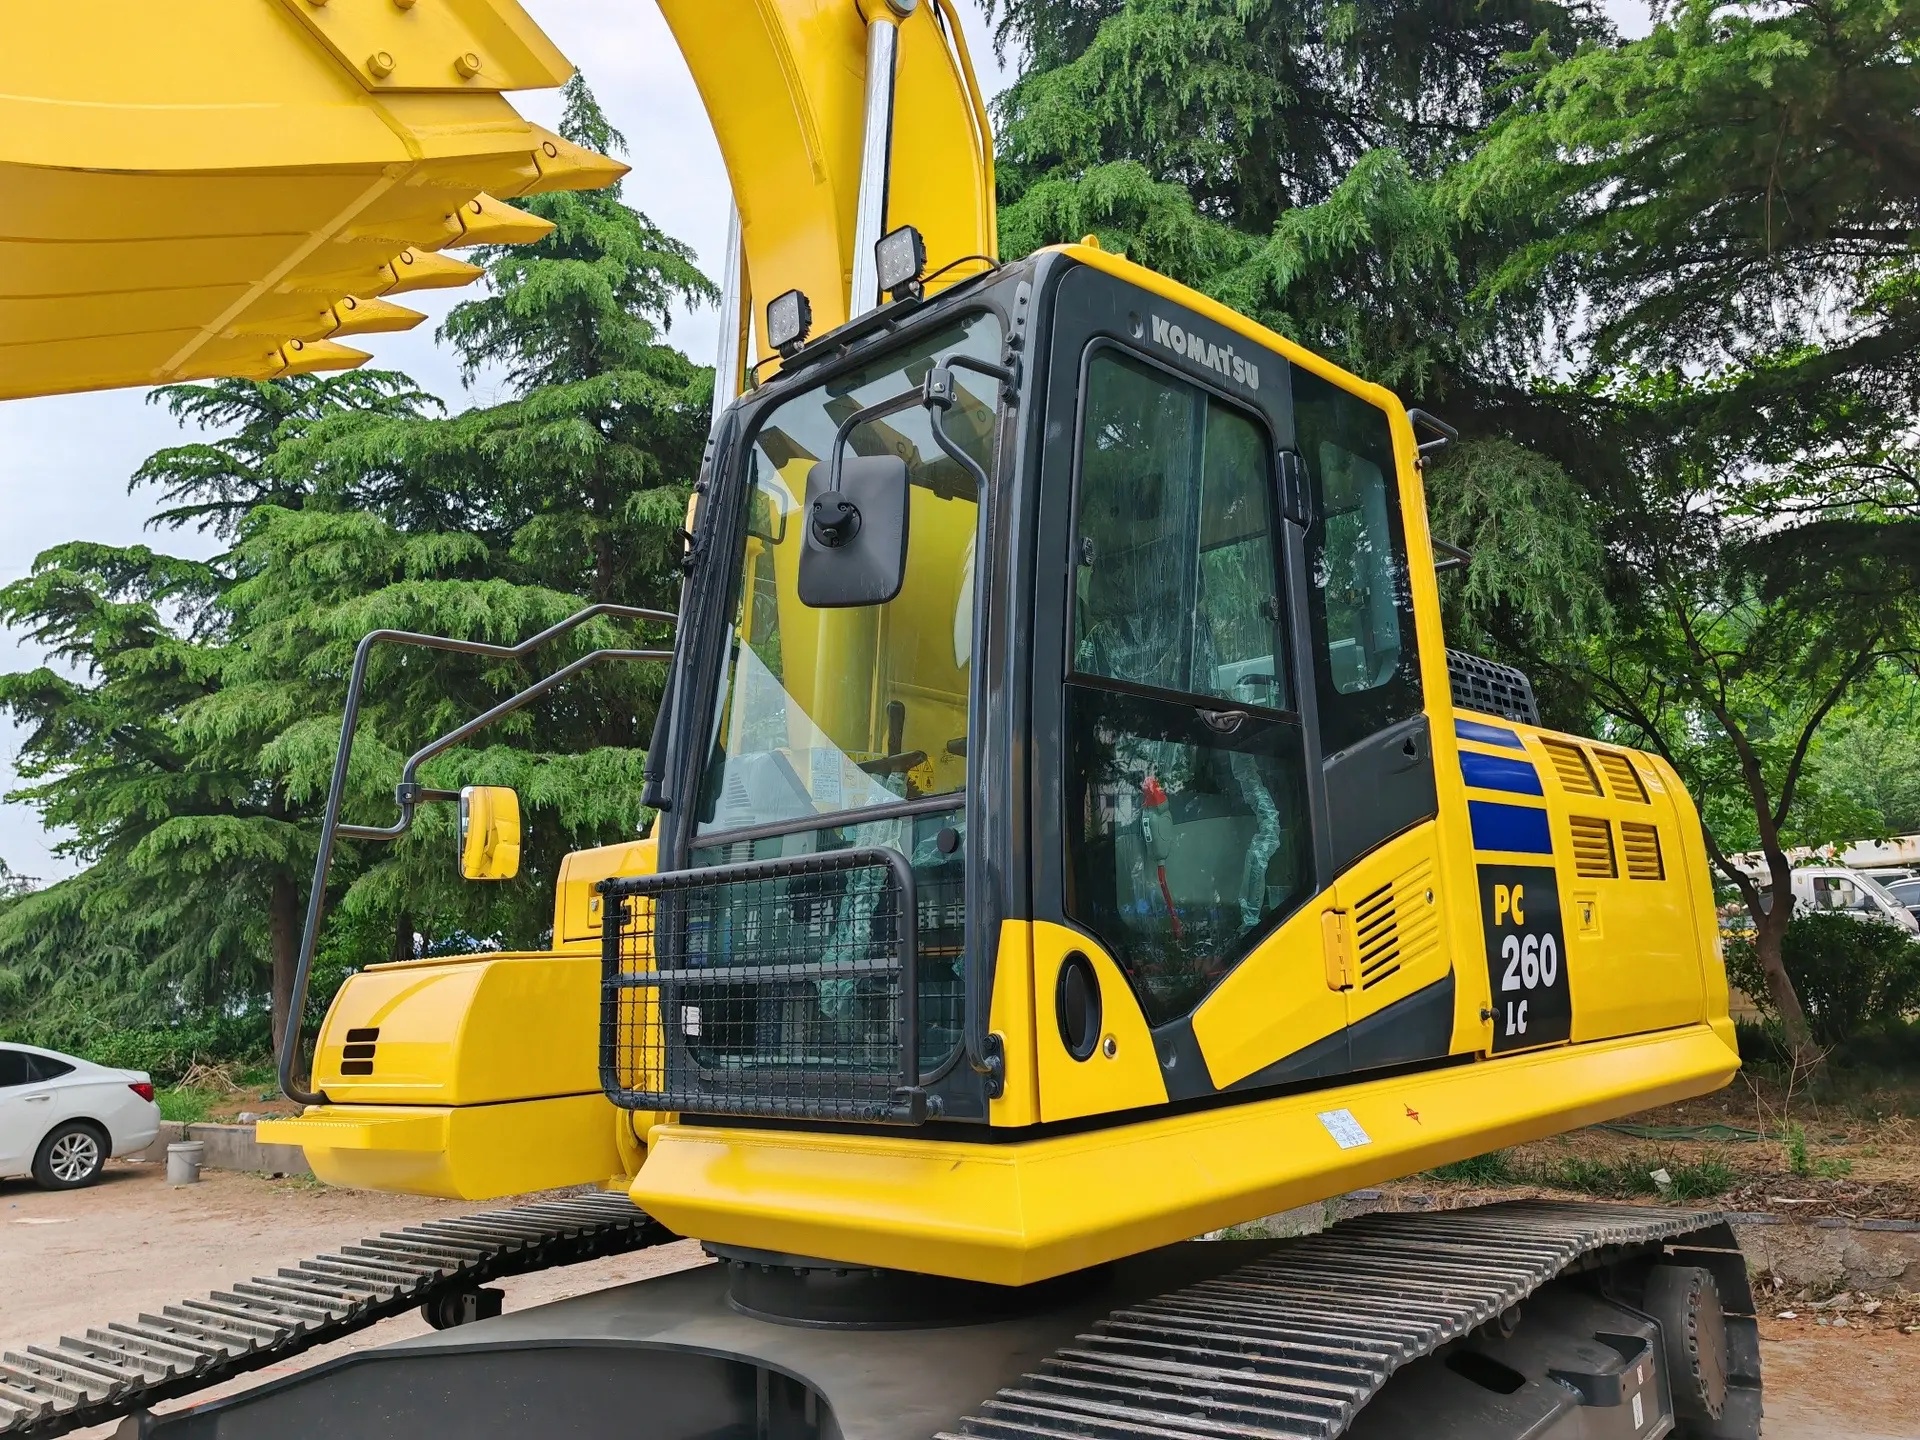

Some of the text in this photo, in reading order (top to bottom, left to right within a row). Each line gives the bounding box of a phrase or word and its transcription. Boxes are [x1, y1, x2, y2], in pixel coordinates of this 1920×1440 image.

[1152, 314, 1260, 390] KOMATSU
[1494, 884, 1525, 926] PC
[1501, 932, 1558, 992] 260
[1505, 999, 1528, 1036] LC
